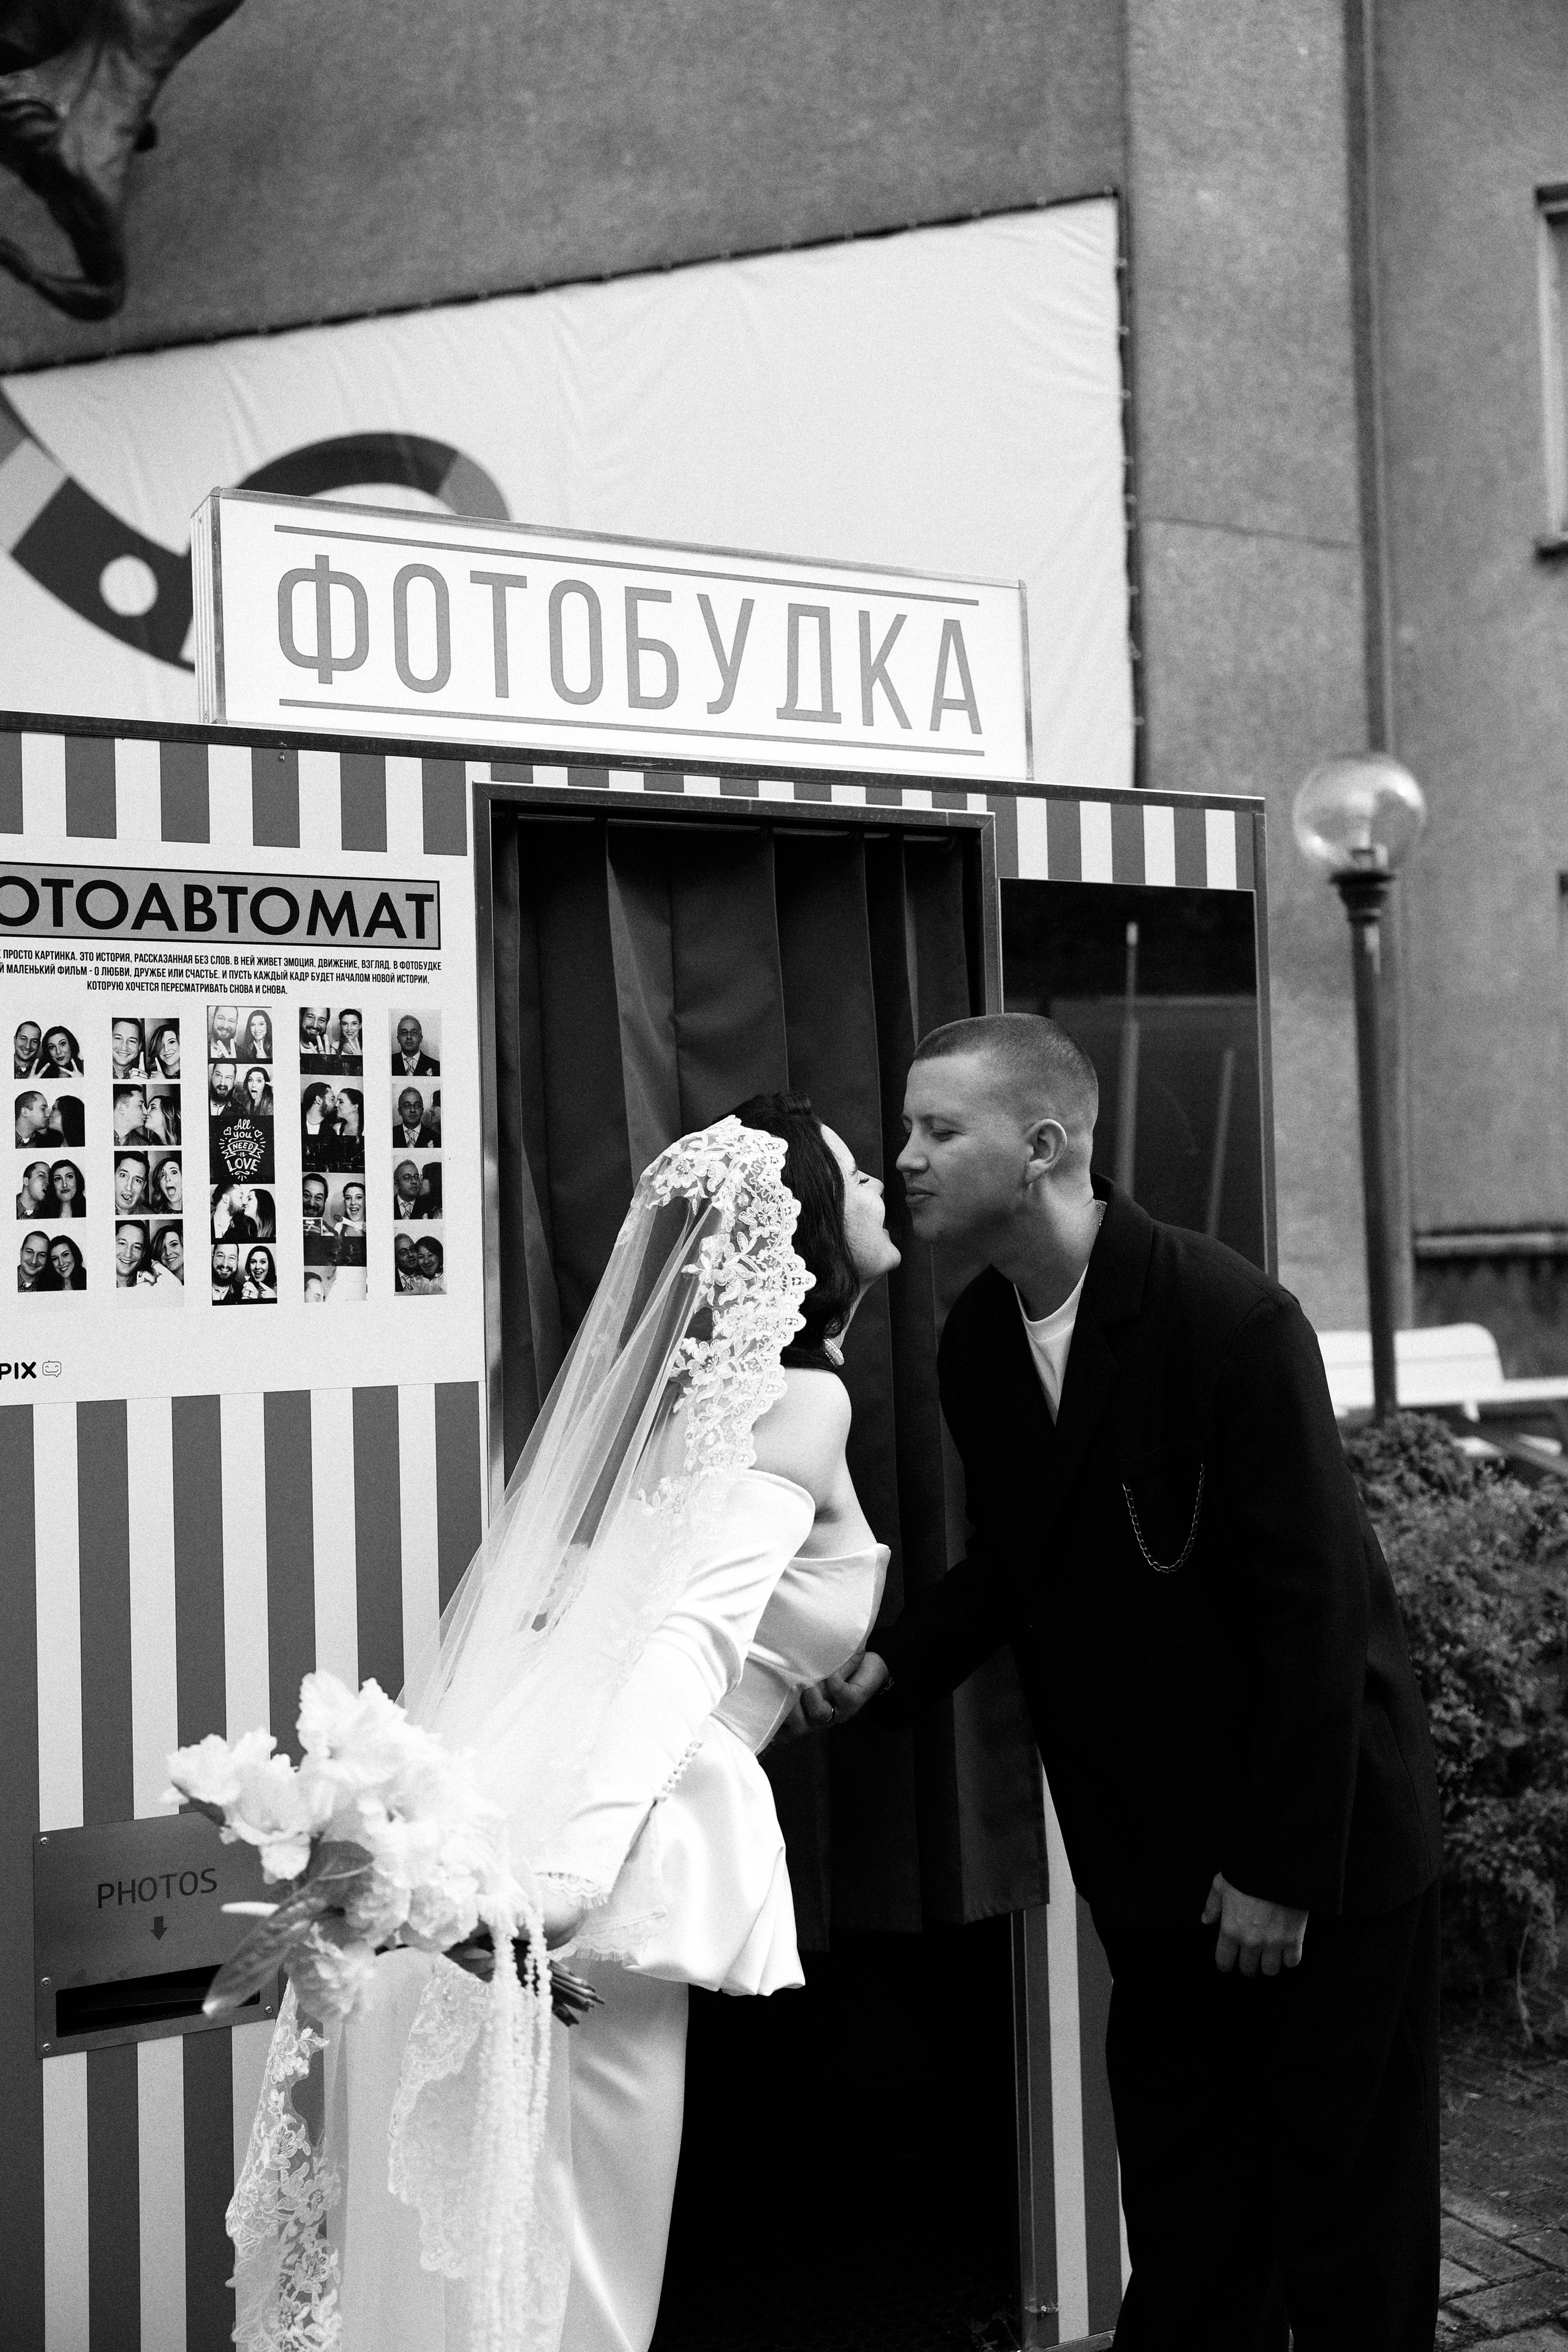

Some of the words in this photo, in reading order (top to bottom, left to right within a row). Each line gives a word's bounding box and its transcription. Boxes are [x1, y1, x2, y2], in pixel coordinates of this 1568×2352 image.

[277, 554, 982, 735] ФОТОБУДКА
[3, 949, 33, 960] ПРОСТО
[34, 950, 77, 961] КАРТИНКА.
[80, 951, 94, 962] ЭТО
[96, 952, 132, 963] ИСТОРИЯ,
[134, 953, 193, 964] РАССКАЗАННАЯ
[194, 955, 209, 965] БЕЗ
[210, 955, 232, 965] СЛОВ.
[233, 956, 239, 965] В
[240, 955, 255, 966] НЕЙ
[257, 957, 282, 967] ЖИВЕТ
[284, 957, 315, 968] ЭМОЦИЯ,
[317, 958, 360, 969] ДВИЖЕНИЕ,
[361, 959, 392, 970] ВЗГЛЯД.
[393, 960, 398, 970] В
[399, 960, 442, 971] ФОТОБУДКЕ
[6, 963, 56, 974] МАЛЕНЬКИЙ
[57, 965, 88, 976] ФИЛЬМ
[94, 966, 99, 976] О
[101, 967, 132, 978] ЛЮБВИ,
[134, 967, 166, 978] ДРУЖБЕ
[168, 968, 184, 978] ИЛИ
[185, 968, 220, 979] СЧАСТЬЕ.
[222, 970, 227, 979] И
[228, 970, 252, 979] ПУСТЬ
[254, 969, 288, 981] КАЖДЫЙ
[290, 971, 309, 982] КАДР
[311, 972, 334, 982] БУДЕТ
[336, 973, 371, 982] НАЧАЛОМ
[372, 972, 395, 983] НОВОЙ
[396, 974, 429, 984] ИСТОРИИ,
[87, 981, 124, 991] КОТОРУЮ
[125, 981, 159, 992] ХОЧЕТСЯ
[160, 982, 228, 993] ПЕРЕСМАТРИВАТЬ
[229, 984, 254, 993] СНОВА
[255, 984, 260, 993] И
[262, 984, 288, 994] СНОВА.
[234, 1118, 251, 1130] All
[228, 1131, 252, 1143] you
[226, 1158, 260, 1172] LOVE
[0, 1362, 37, 1380] PIX
[97, 1868, 217, 1909] PHOTOS
